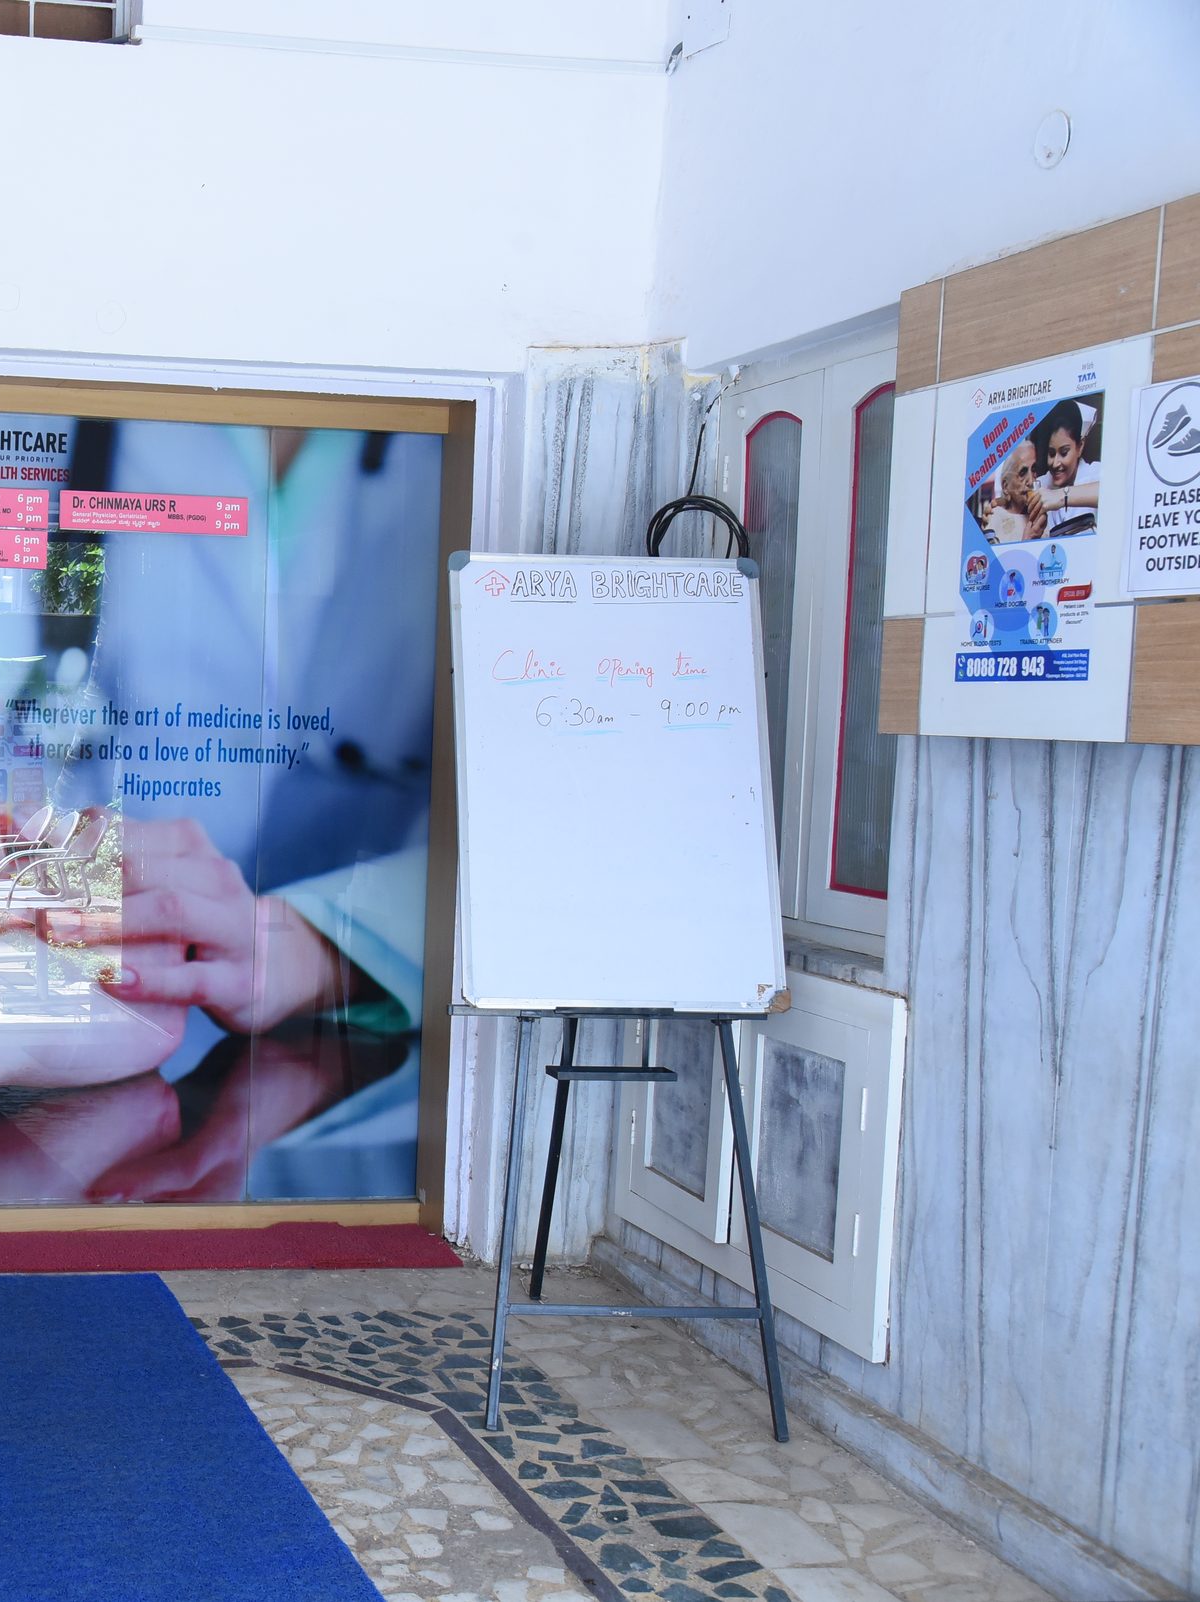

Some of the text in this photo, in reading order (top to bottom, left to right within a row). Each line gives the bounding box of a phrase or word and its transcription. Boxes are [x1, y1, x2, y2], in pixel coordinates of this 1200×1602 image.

[1077, 372, 1096, 382] TATA
[988, 389, 1005, 405] ARYA
[1007, 380, 1052, 402] BRIGHTCARE
[983, 416, 1008, 450] Home
[968, 454, 997, 488] Health
[996, 411, 1035, 458] Services
[20, 467, 70, 483] SERVICES
[17, 494, 24, 503] 6
[26, 495, 42, 506] pm
[72, 496, 240, 512] Dr. CHINMAYA URS R 9 am
[1154, 488, 1200, 507] PLEASE
[17, 513, 42, 525] 9 pm
[186, 514, 207, 522] (PGDG)
[215, 521, 240, 531] 9 pm
[1138, 509, 1200, 529] LEAVE YO
[15, 535, 21, 544] 6
[23, 536, 39, 547] pm
[1140, 532, 1200, 550] FOOTWE
[14, 554, 39, 566] 8 pm
[1146, 555, 1200, 571] OUTSID
[510, 570, 744, 599] ARYA BRIGHTCARE
[1032, 578, 1069, 586] PHYSIOTHERAPY
[492, 649, 566, 681] Clinic
[672, 651, 707, 677] time
[967, 656, 1044, 677] 8088 728 943
[102, 700, 129, 727] the
[135, 706, 159, 727] art
[165, 702, 183, 728] of
[187, 704, 262, 730] medicine
[268, 708, 280, 731] is
[287, 706, 335, 736] loved,
[661, 699, 709, 724] 9:00
[717, 705, 742, 721] pm
[28, 733, 72, 759] there
[79, 738, 92, 759] is
[99, 736, 132, 761] also
[139, 744, 148, 761] a
[155, 737, 189, 762] love
[194, 738, 212, 764] of
[117, 772, 221, 801] -Hippocrates
